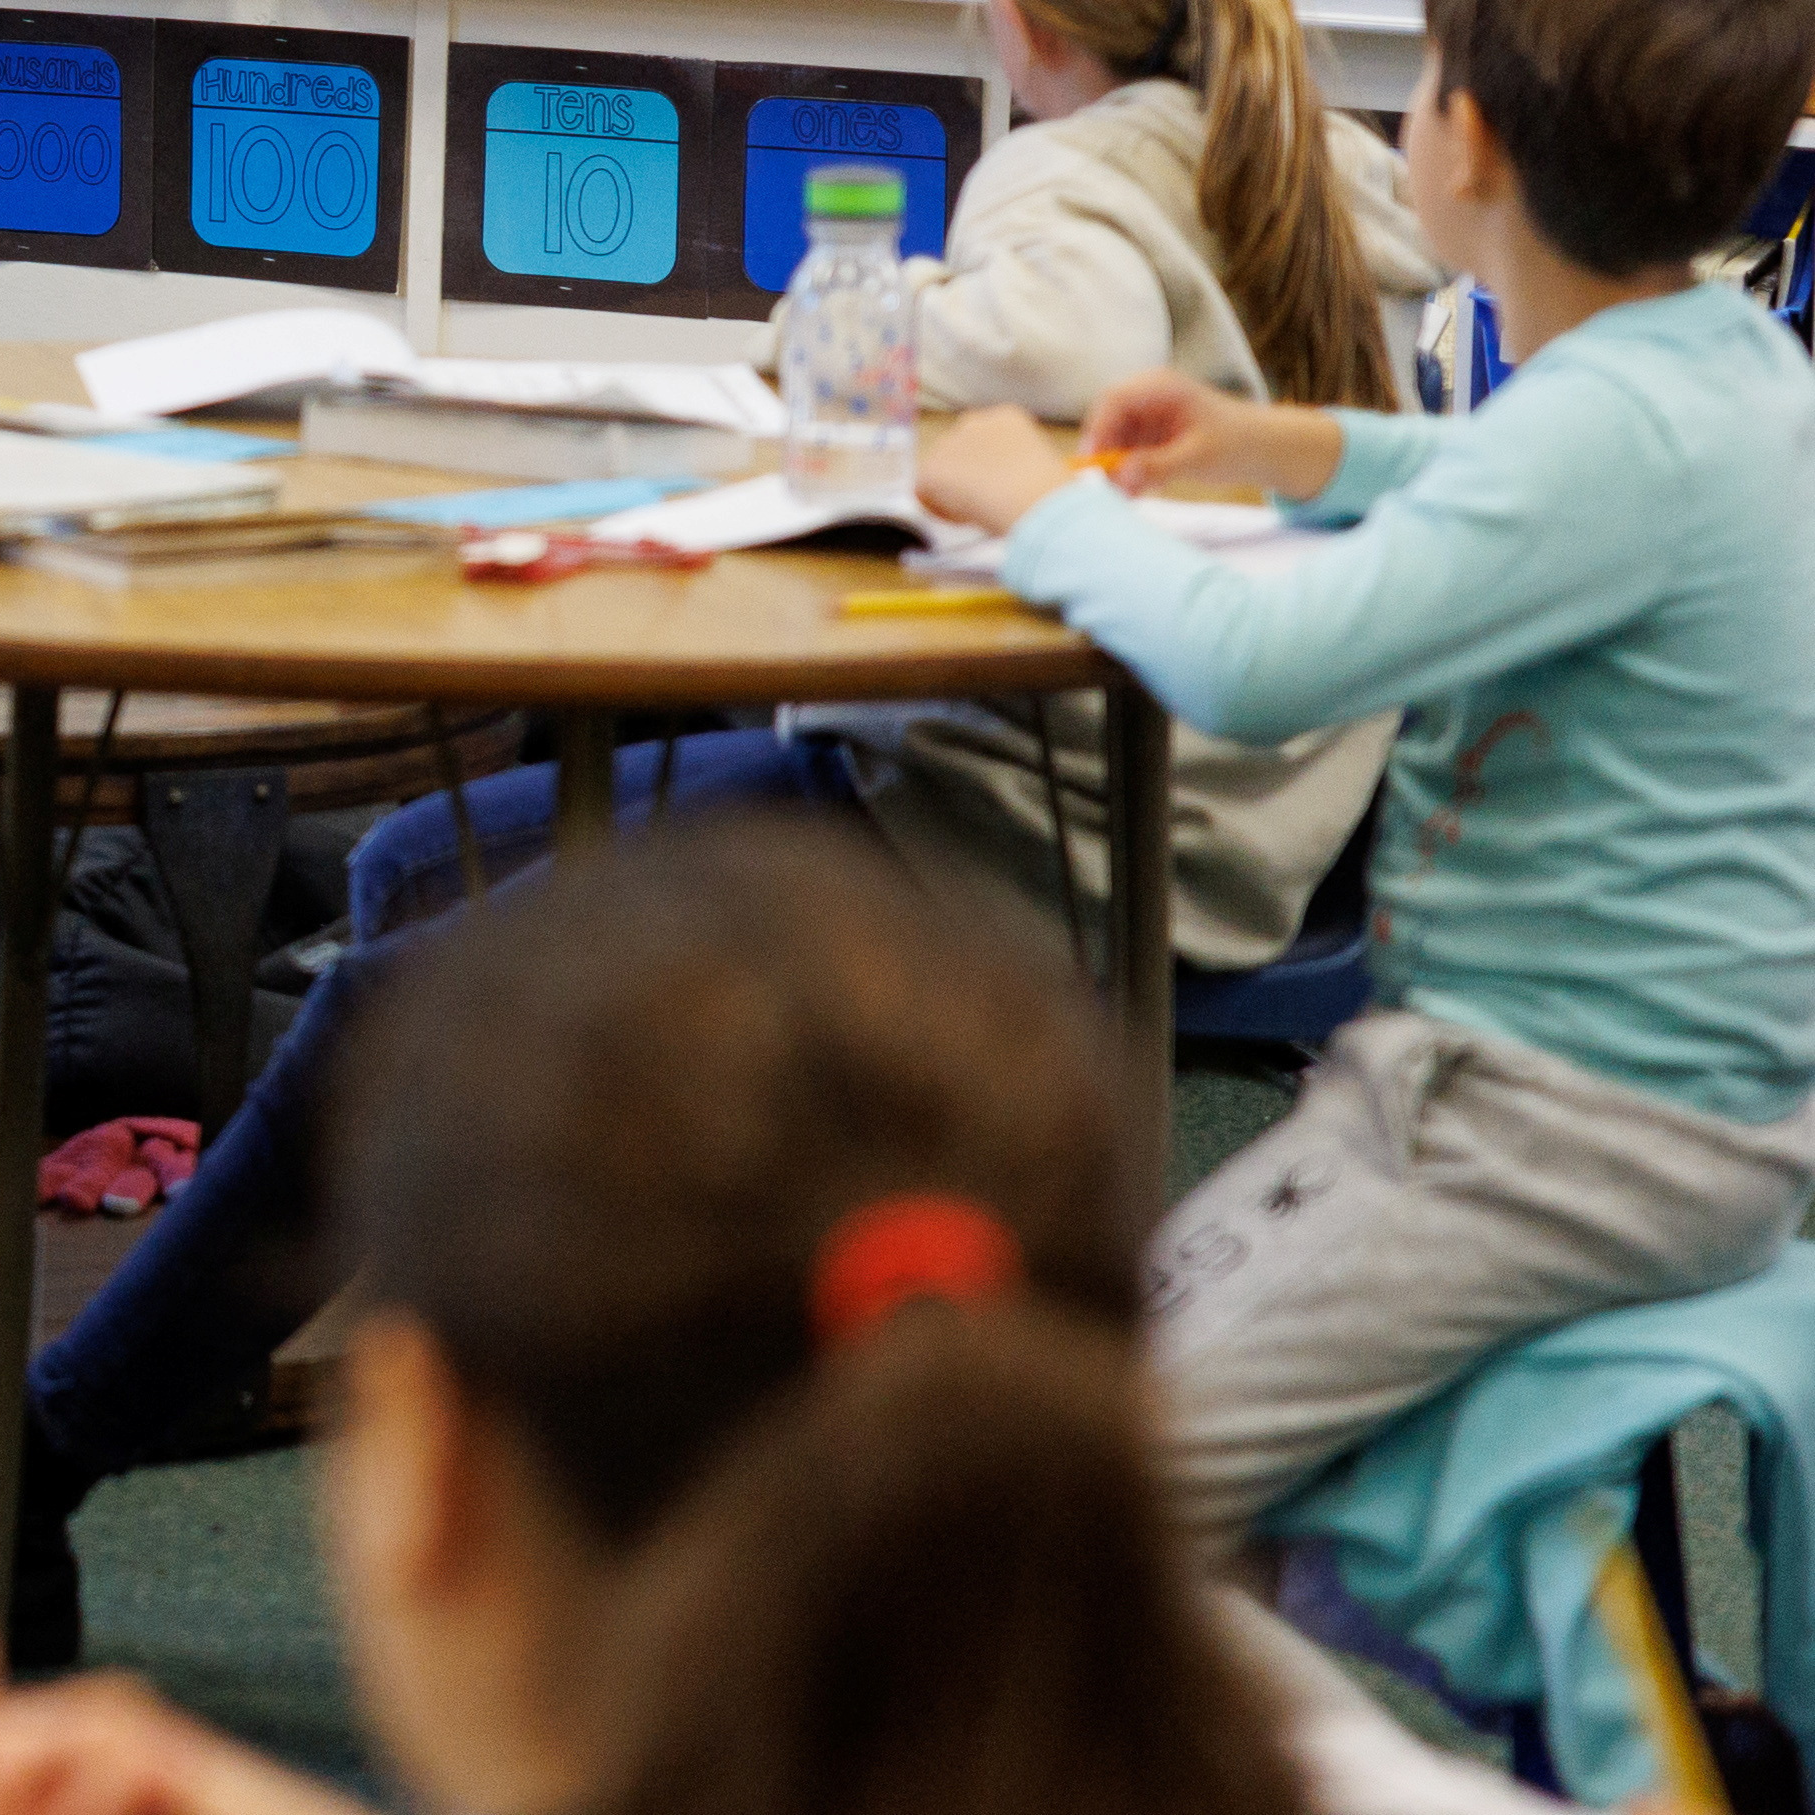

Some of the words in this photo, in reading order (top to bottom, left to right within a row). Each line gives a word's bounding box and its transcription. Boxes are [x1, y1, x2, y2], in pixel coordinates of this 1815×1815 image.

[200, 66, 374, 112] Hundreds
[533, 86, 636, 138] Tens
[209, 120, 368, 231] 100
[543, 150, 635, 257] 10
